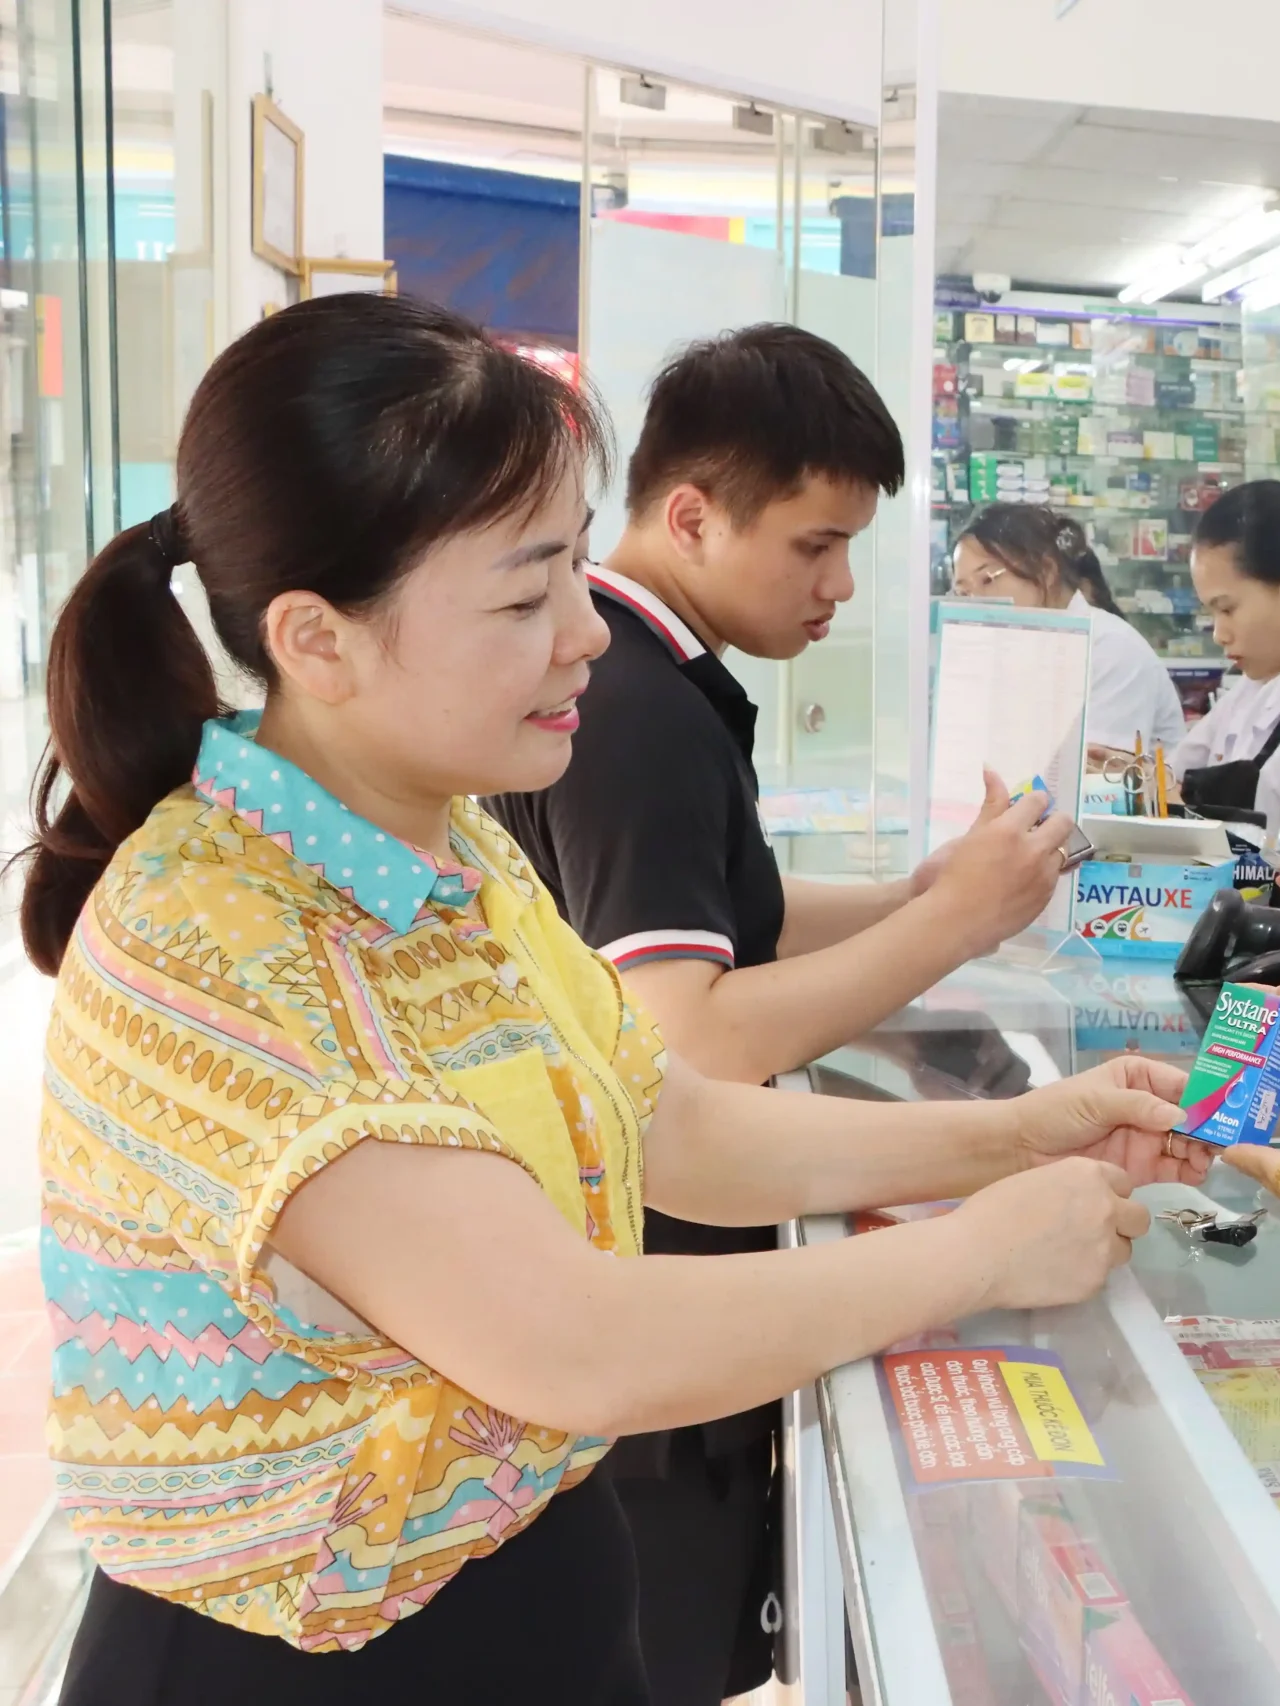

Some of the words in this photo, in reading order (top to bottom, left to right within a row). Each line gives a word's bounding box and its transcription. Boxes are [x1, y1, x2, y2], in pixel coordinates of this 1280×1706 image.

[1076, 884, 1193, 909] SAYTAUXE
[1216, 991, 1279, 1027] Systane
[1228, 1016, 1267, 1036] ULTRA
[1211, 1044, 1226, 1057] HIGH
[1225, 1048, 1264, 1066] PERFORMANCE
[1211, 1111, 1240, 1128] Alcon
[977, 1374, 1001, 1397] khách
[1021, 1371, 1045, 1389] MUA
[1029, 1390, 1066, 1418] THUỐC
